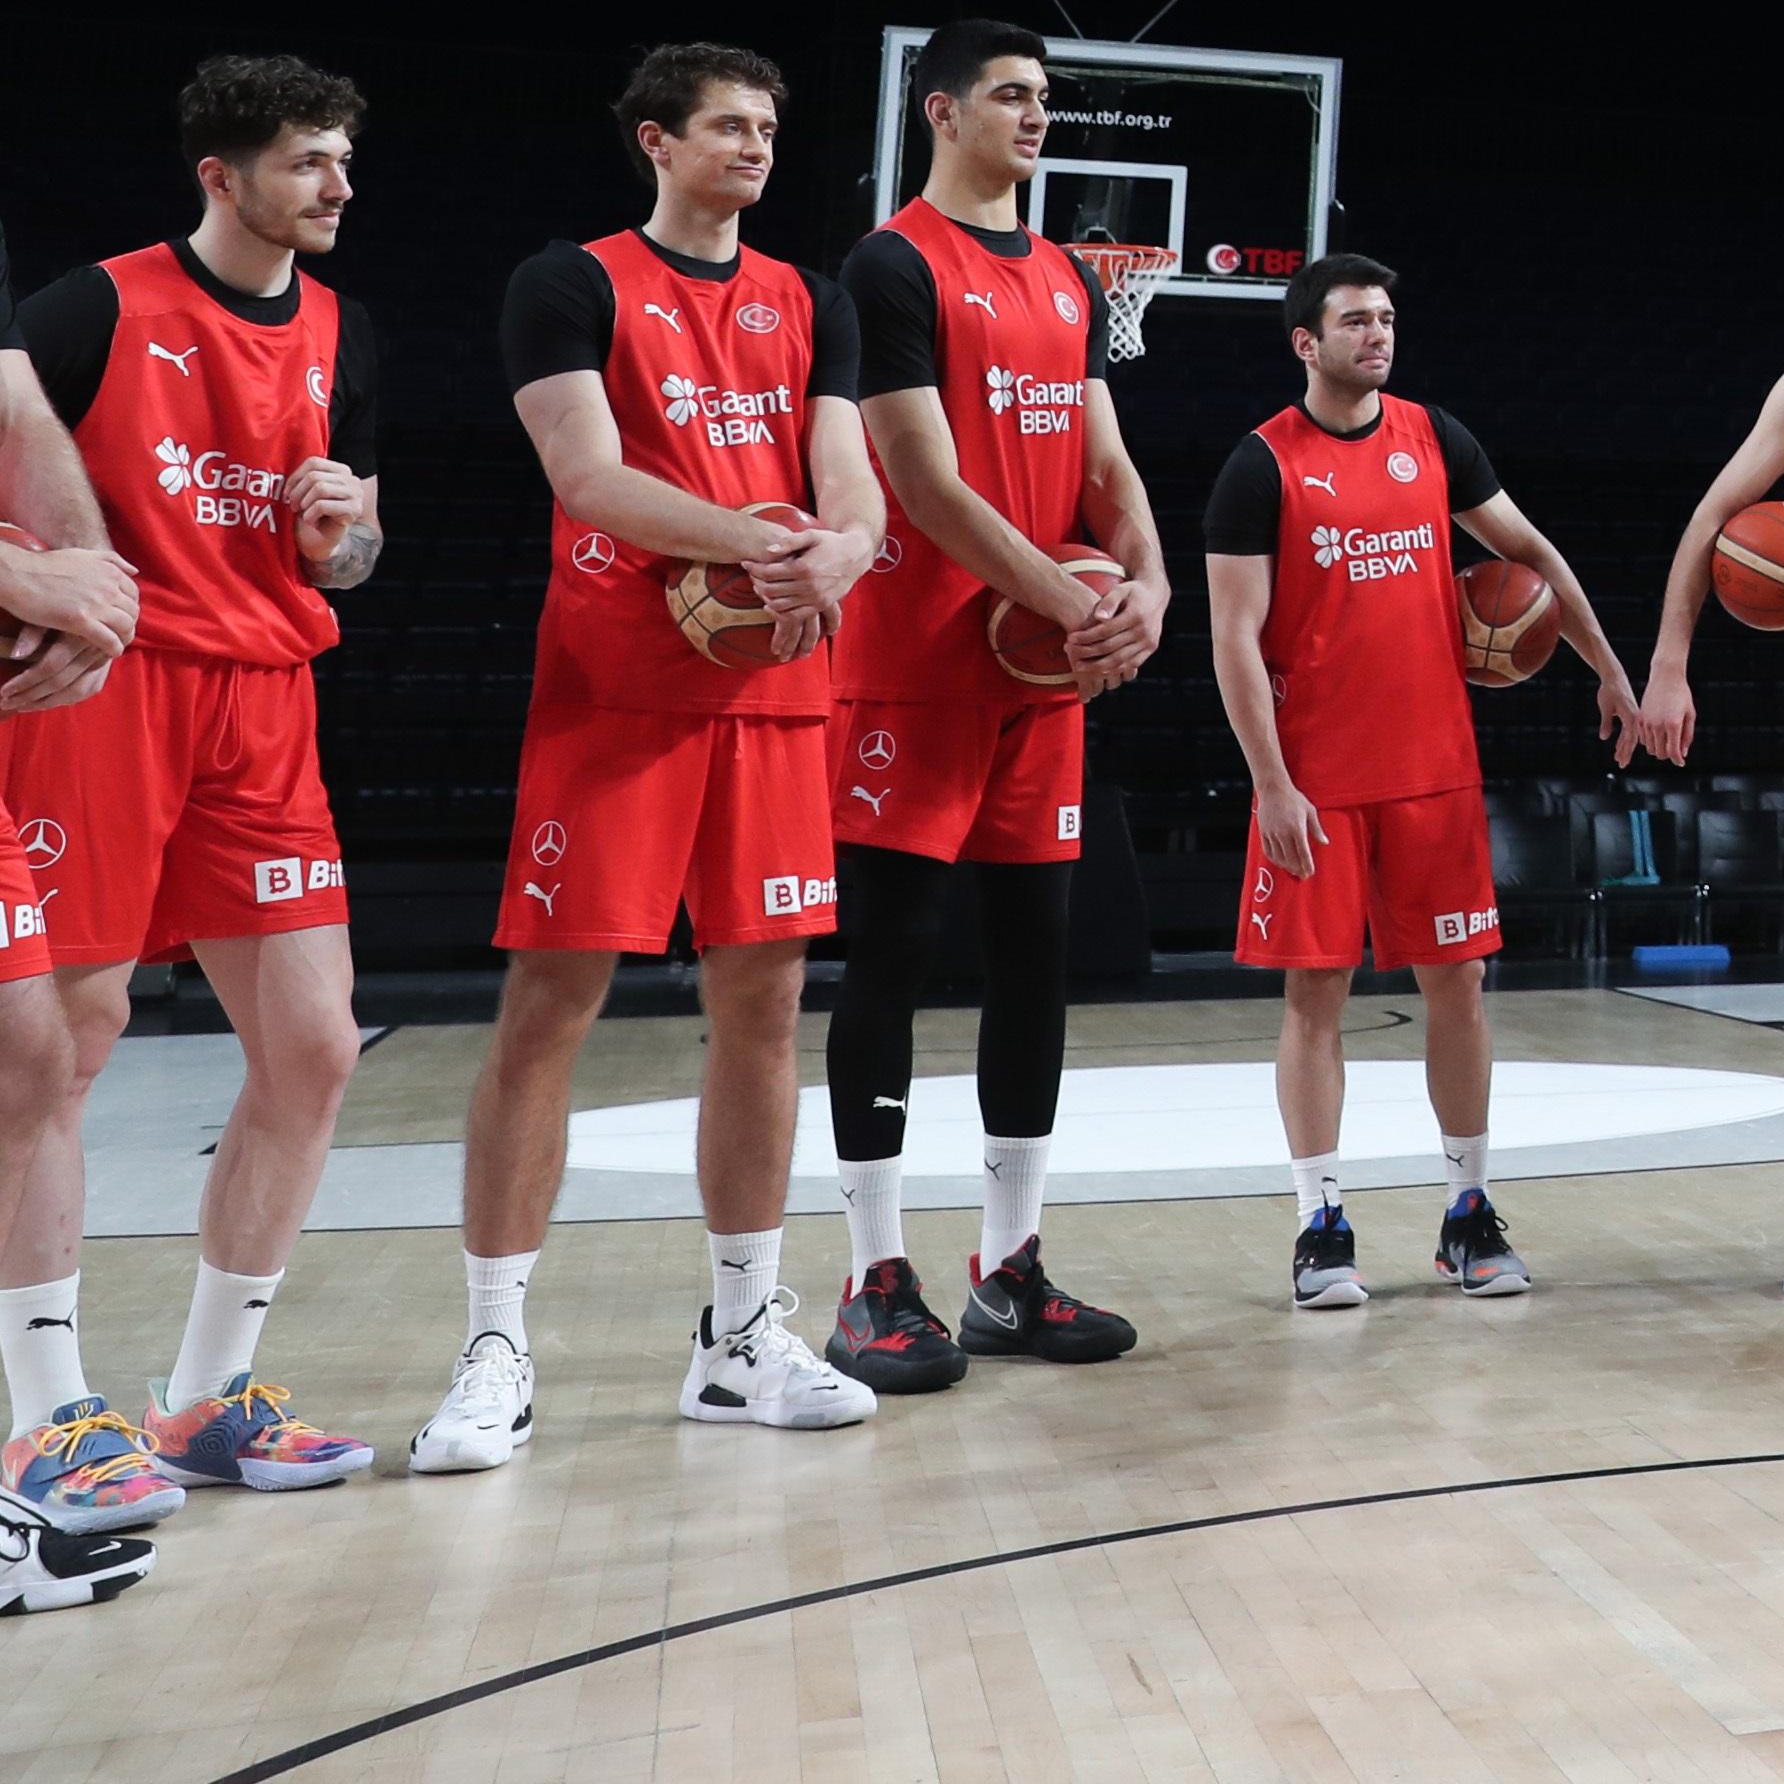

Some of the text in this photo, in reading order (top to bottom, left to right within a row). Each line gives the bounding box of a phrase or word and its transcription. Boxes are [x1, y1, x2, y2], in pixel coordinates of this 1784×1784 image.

[1046, 110, 1172, 130] www.tbf.org.tr
[1243, 247, 1303, 276] TBF
[196, 496, 276, 533] BBVA
[1344, 522, 1434, 556] Garanti
[1348, 552, 1418, 582] BBVA
